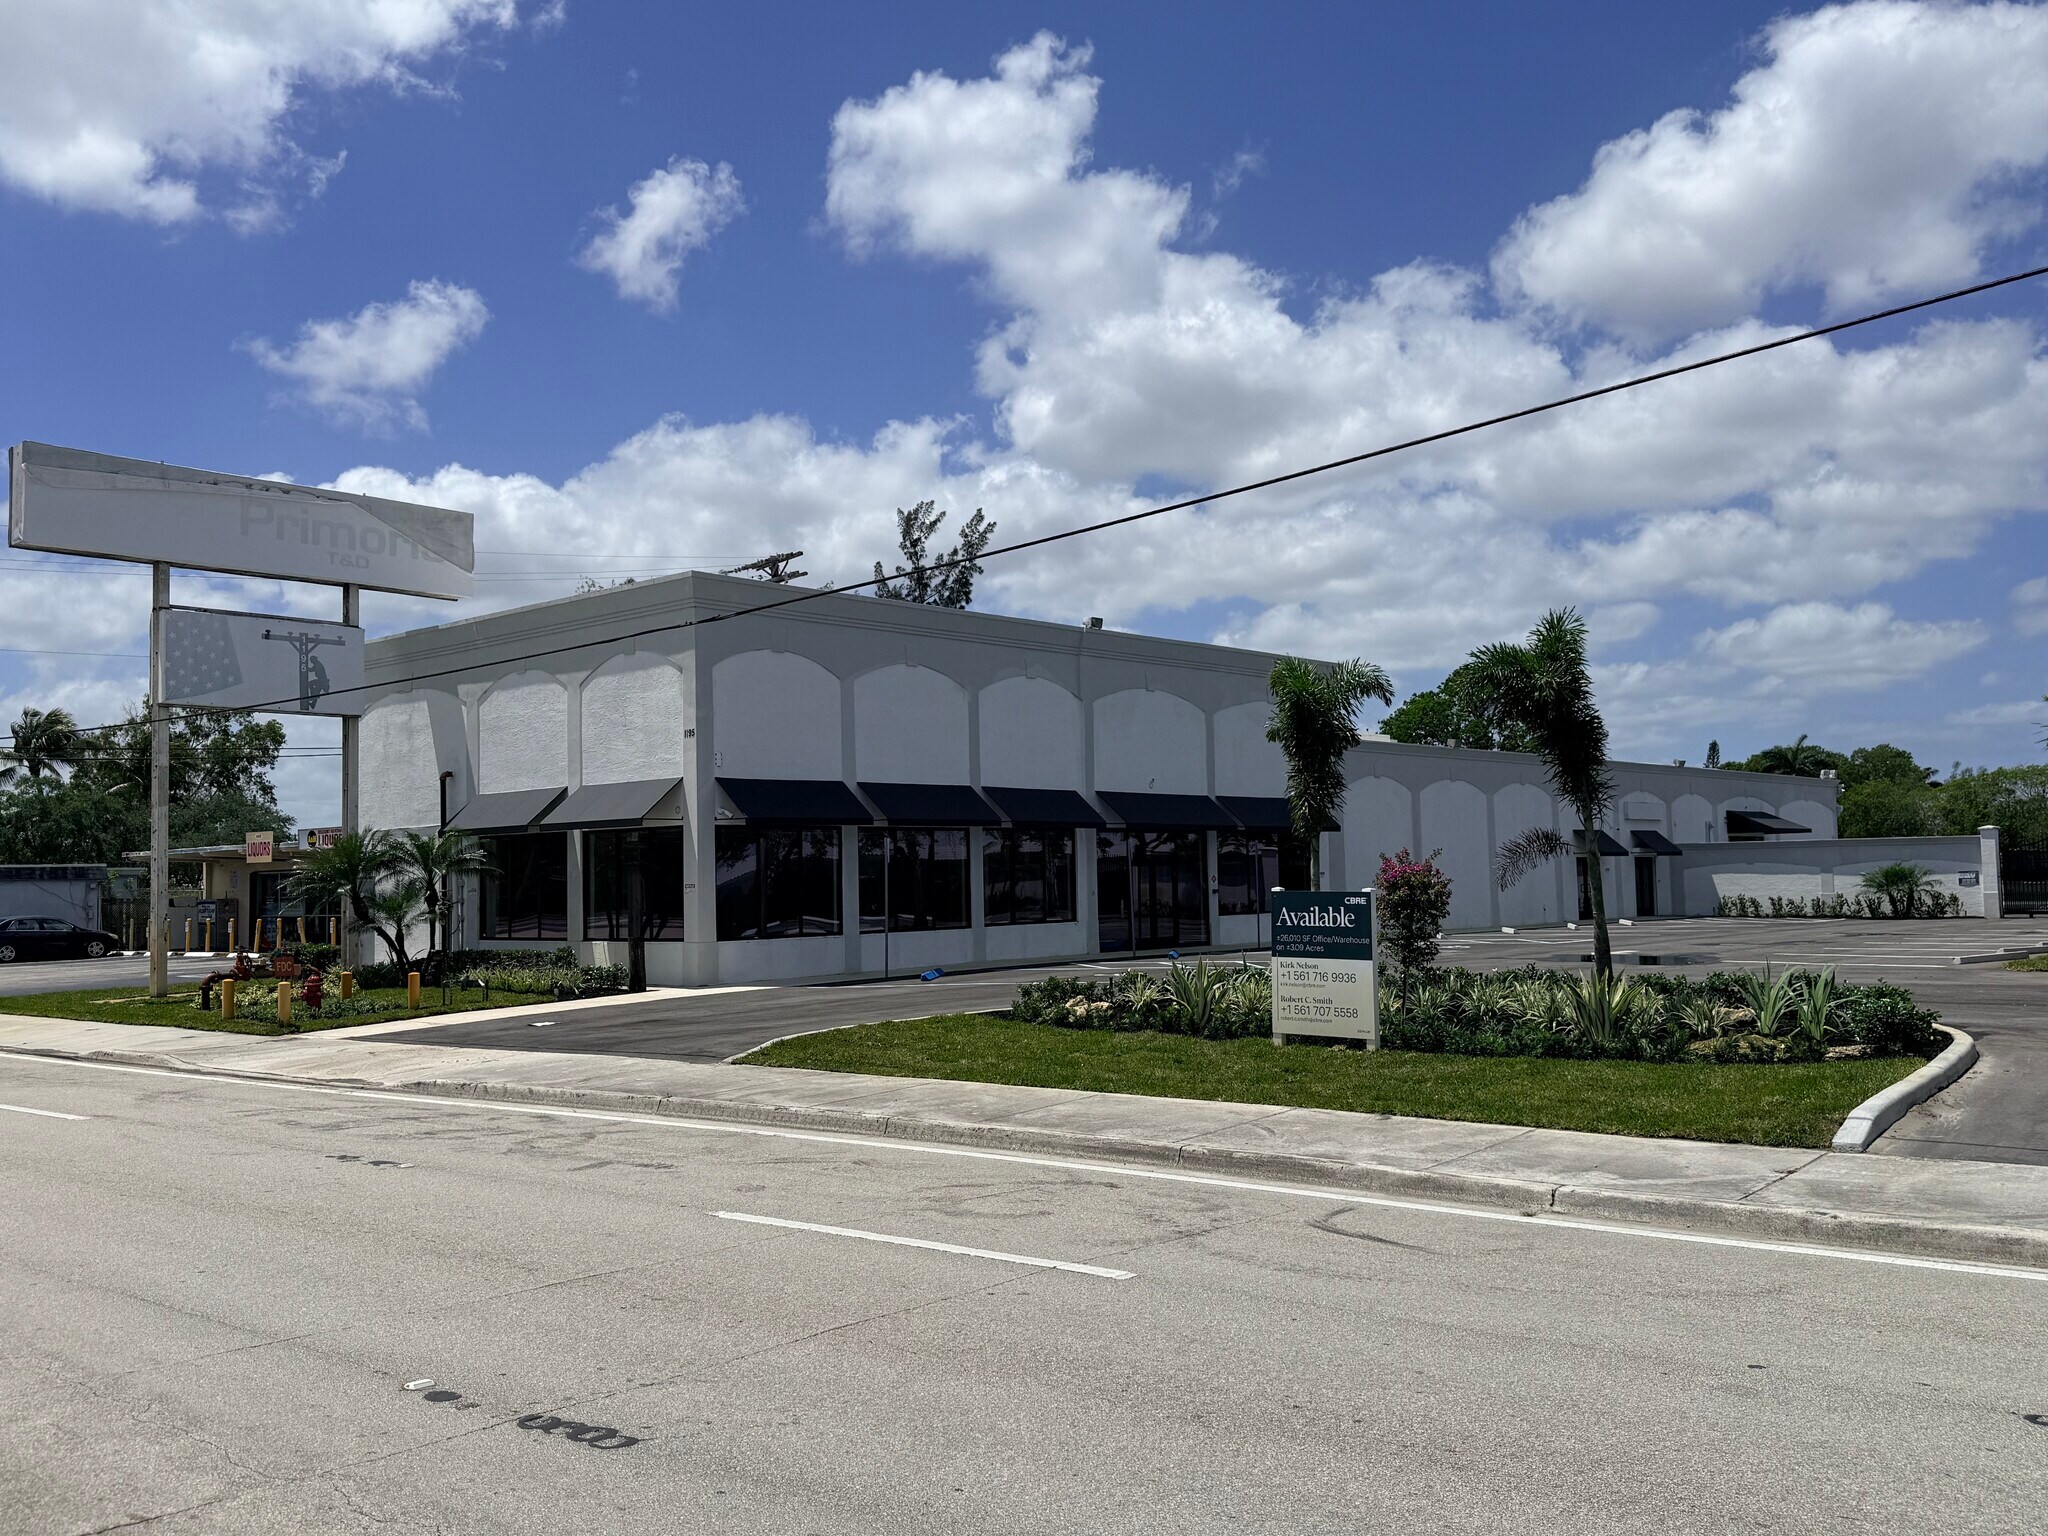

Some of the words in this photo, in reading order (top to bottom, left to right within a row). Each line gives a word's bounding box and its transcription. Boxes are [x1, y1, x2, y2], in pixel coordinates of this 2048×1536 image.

[326, 552, 370, 569] T&D
[684, 729, 695, 738] 1195
[248, 841, 270, 857] LIQUORS
[1276, 906, 1355, 927] Available
[1312, 935, 1370, 944] Office/Warehouse
[1305, 944, 1324, 952] Acres
[276, 961, 292, 971] FDC
[1281, 971, 1291, 980] +1
[1293, 971, 1310, 981] 561
[1312, 971, 1329, 982] 716
[1331, 972, 1357, 983] 9936
[1280, 995, 1304, 1003] Robert
[1304, 996, 1311, 1004] C.
[1312, 997, 1333, 1005] Smith
[1281, 1004, 1291, 1014] +1
[1294, 1005, 1310, 1015] 561
[1312, 1006, 1331, 1016] 707
[1333, 1007, 1359, 1018] 5558
